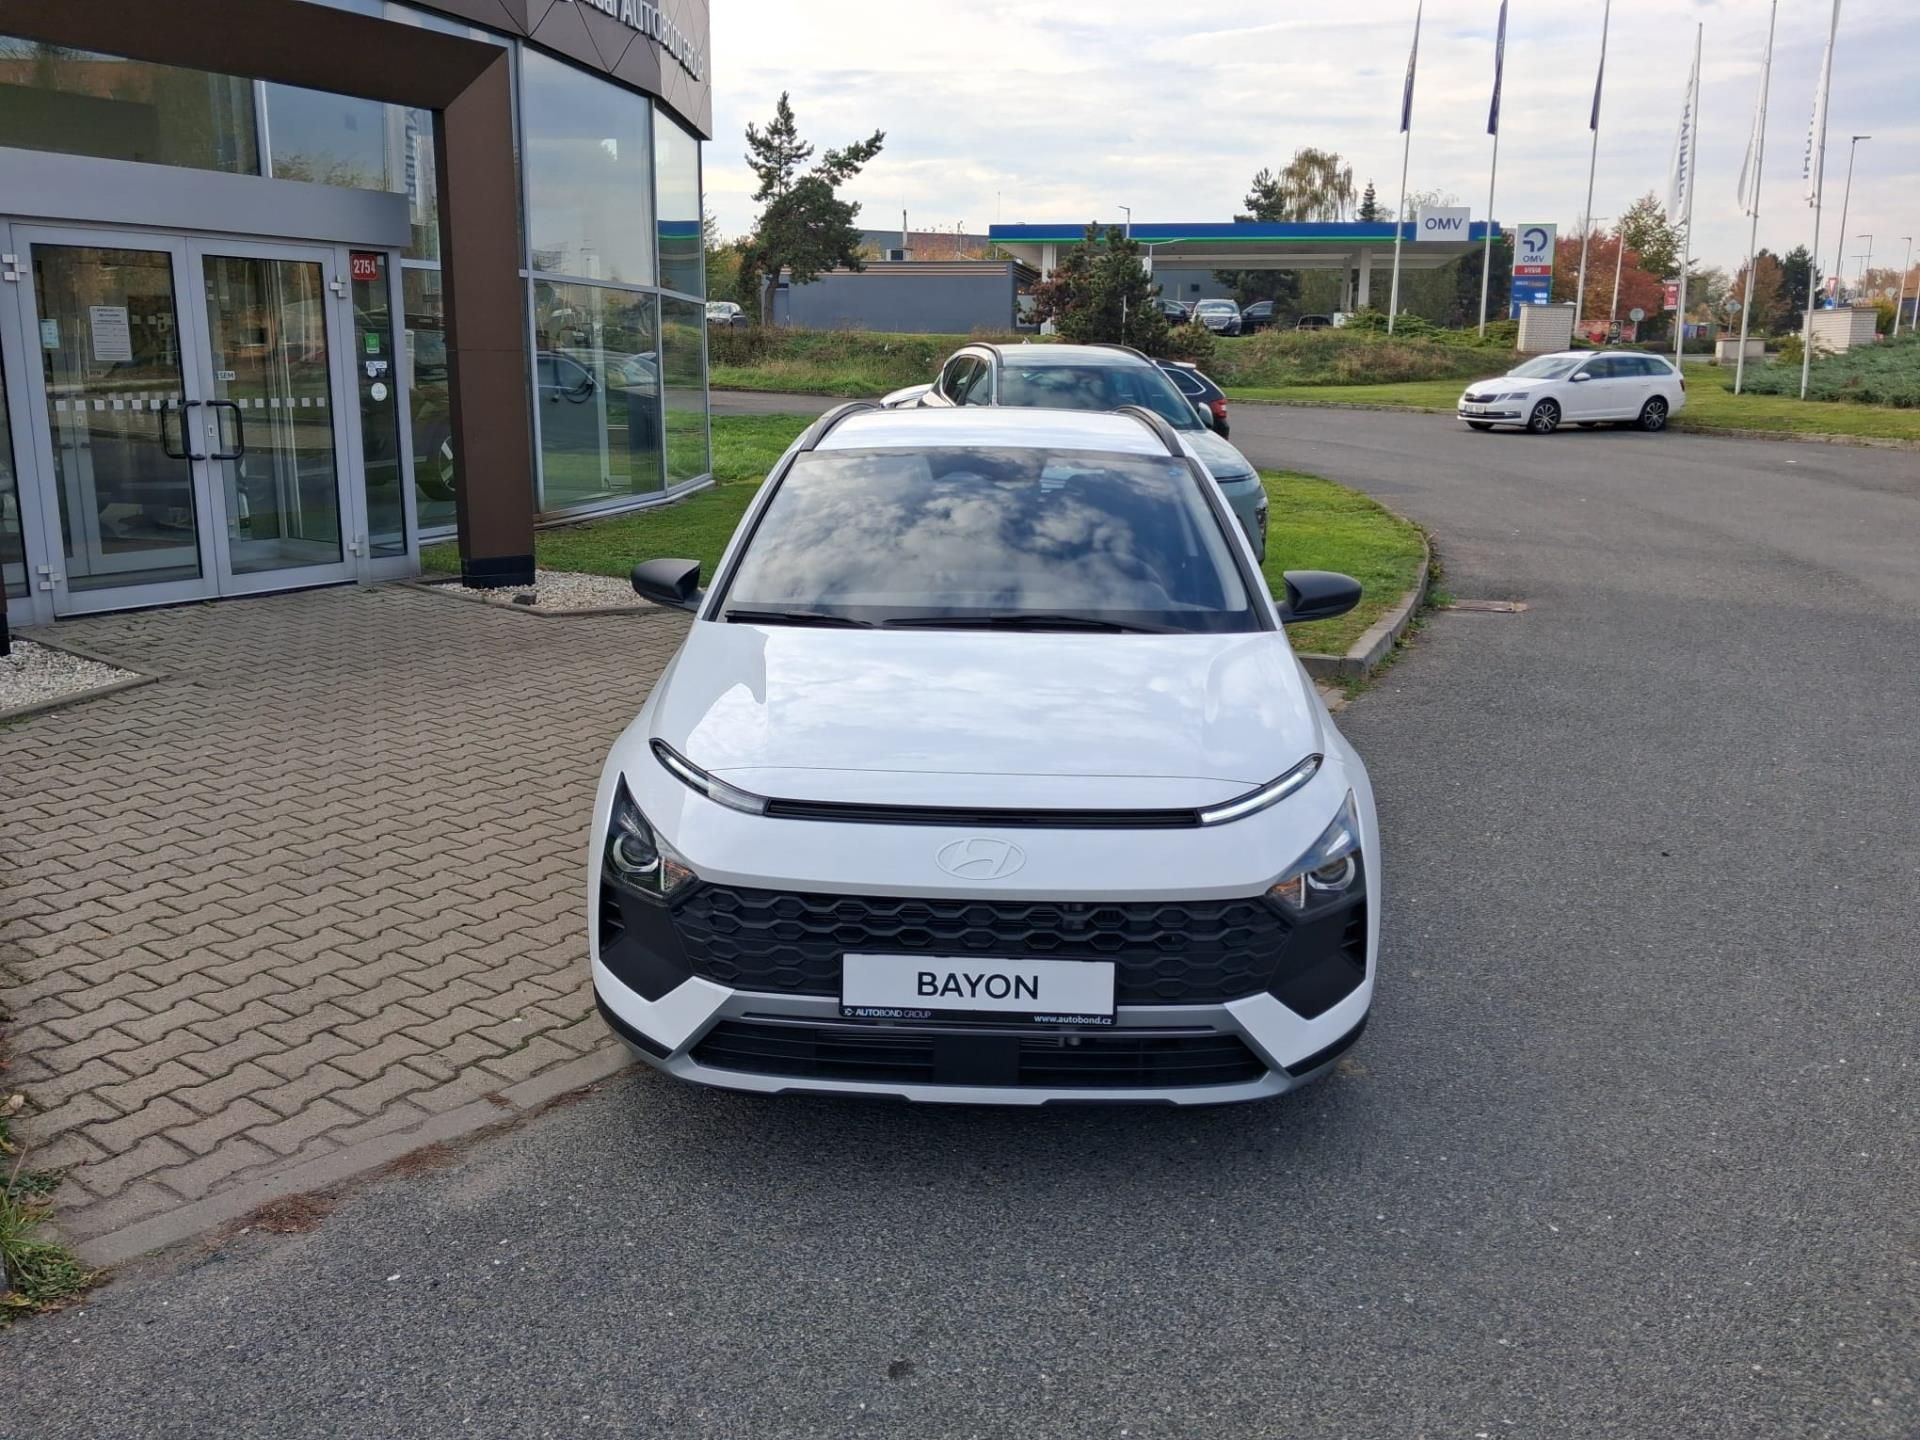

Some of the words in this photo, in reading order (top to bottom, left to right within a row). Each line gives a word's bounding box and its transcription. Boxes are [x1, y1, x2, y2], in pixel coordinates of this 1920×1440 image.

[1425, 217, 1463, 230] OMV
[1522, 255, 1545, 263] OMV
[353, 259, 376, 274] 2754
[916, 971, 1039, 1000] BAYON
[855, 1008, 902, 1017] AUTOBOND
[903, 1009, 931, 1019] GROUP
[1033, 1015, 1113, 1025] www.autobond.cz
